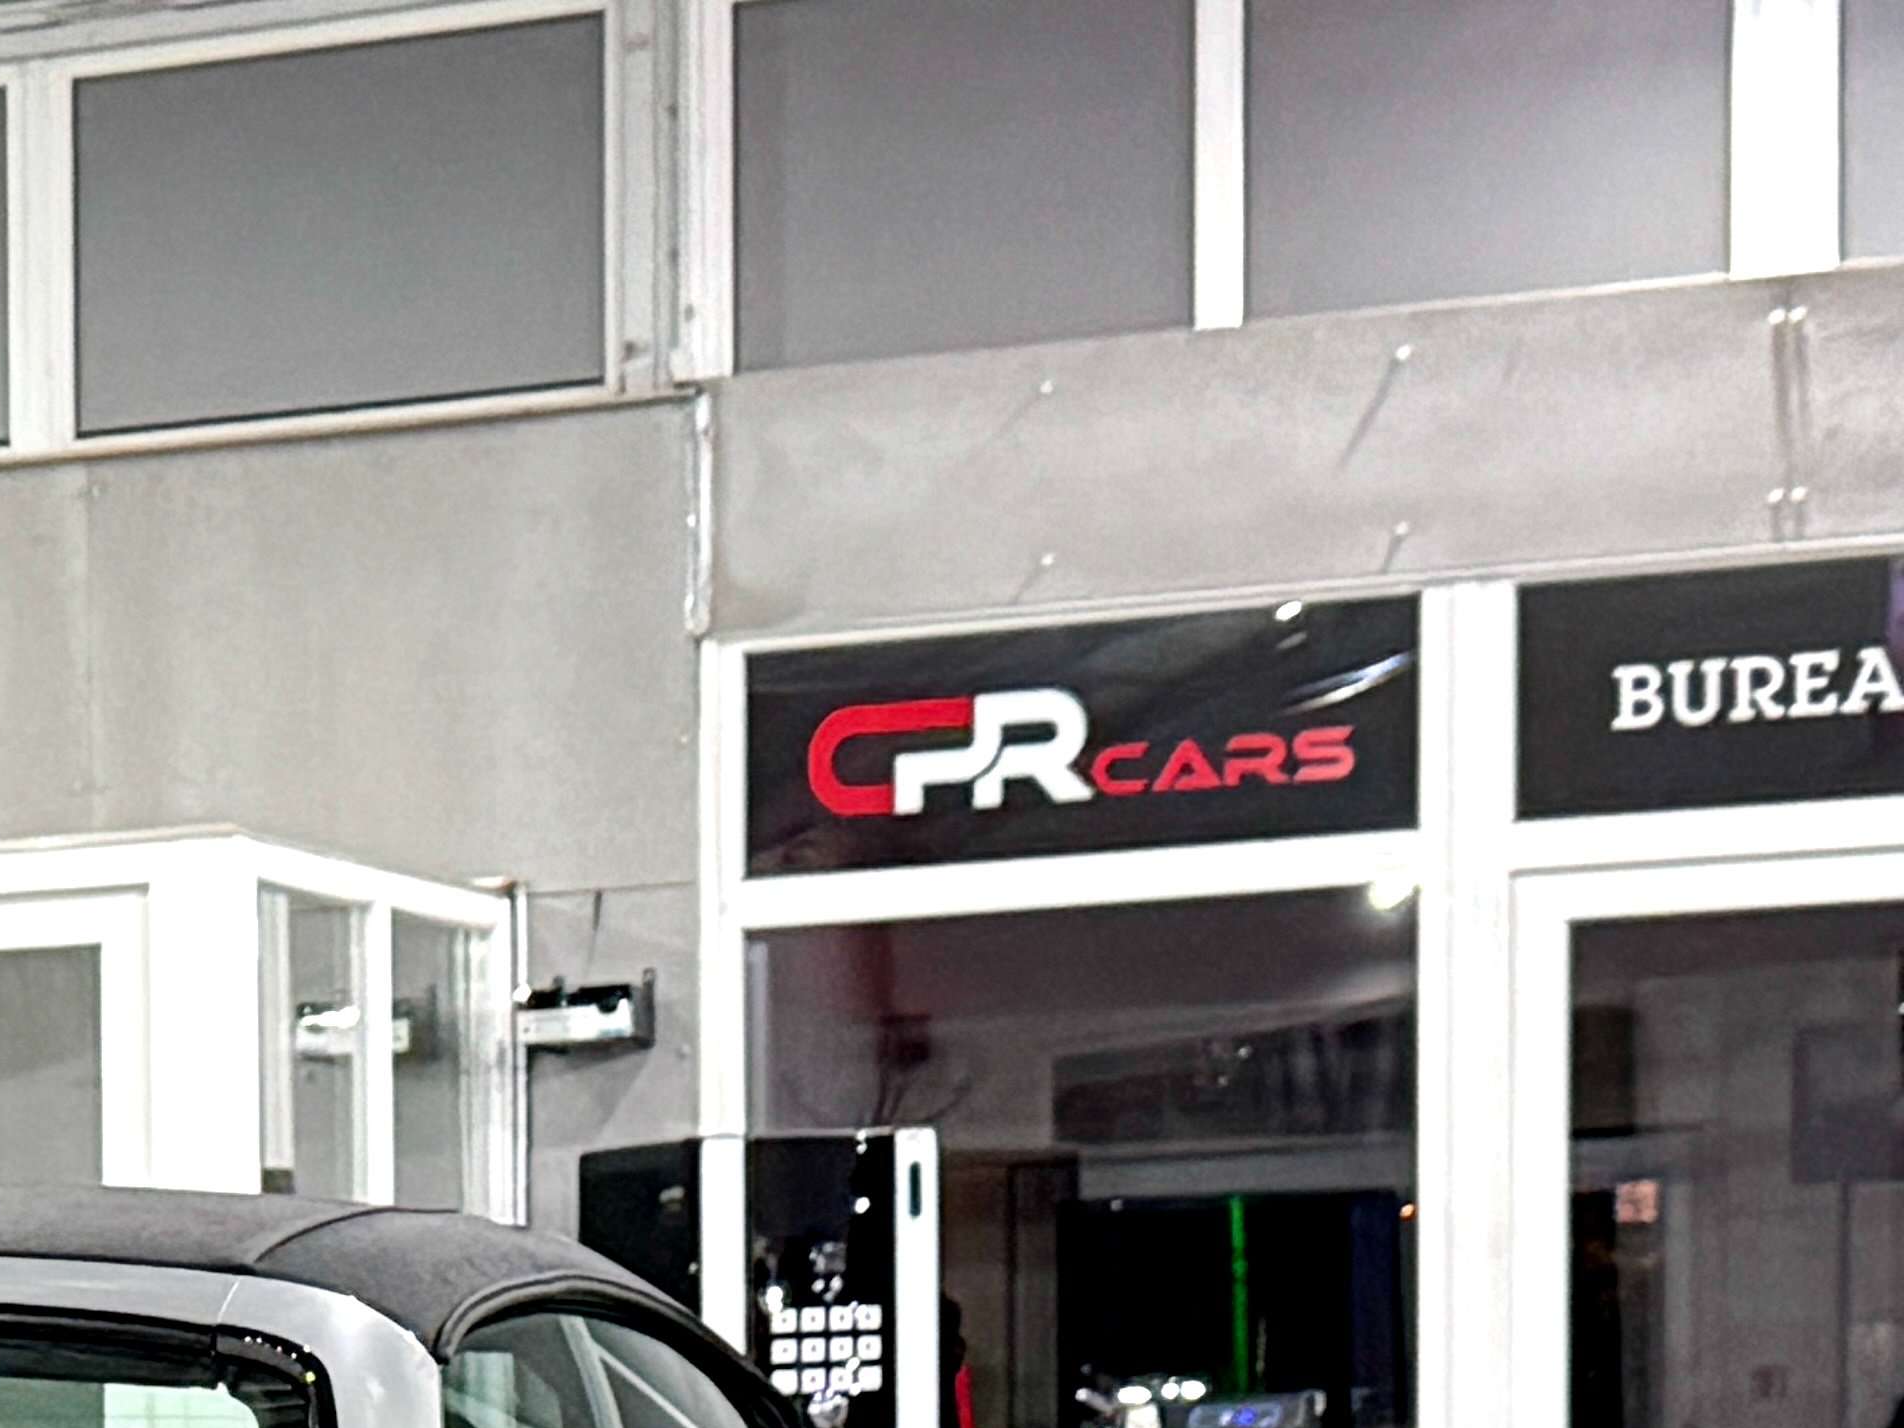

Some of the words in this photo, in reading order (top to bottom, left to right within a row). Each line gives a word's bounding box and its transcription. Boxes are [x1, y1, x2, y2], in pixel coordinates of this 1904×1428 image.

[1611, 646, 1904, 731] BUREA
[807, 688, 1093, 818] CPR
[1090, 727, 1355, 797] CARS
